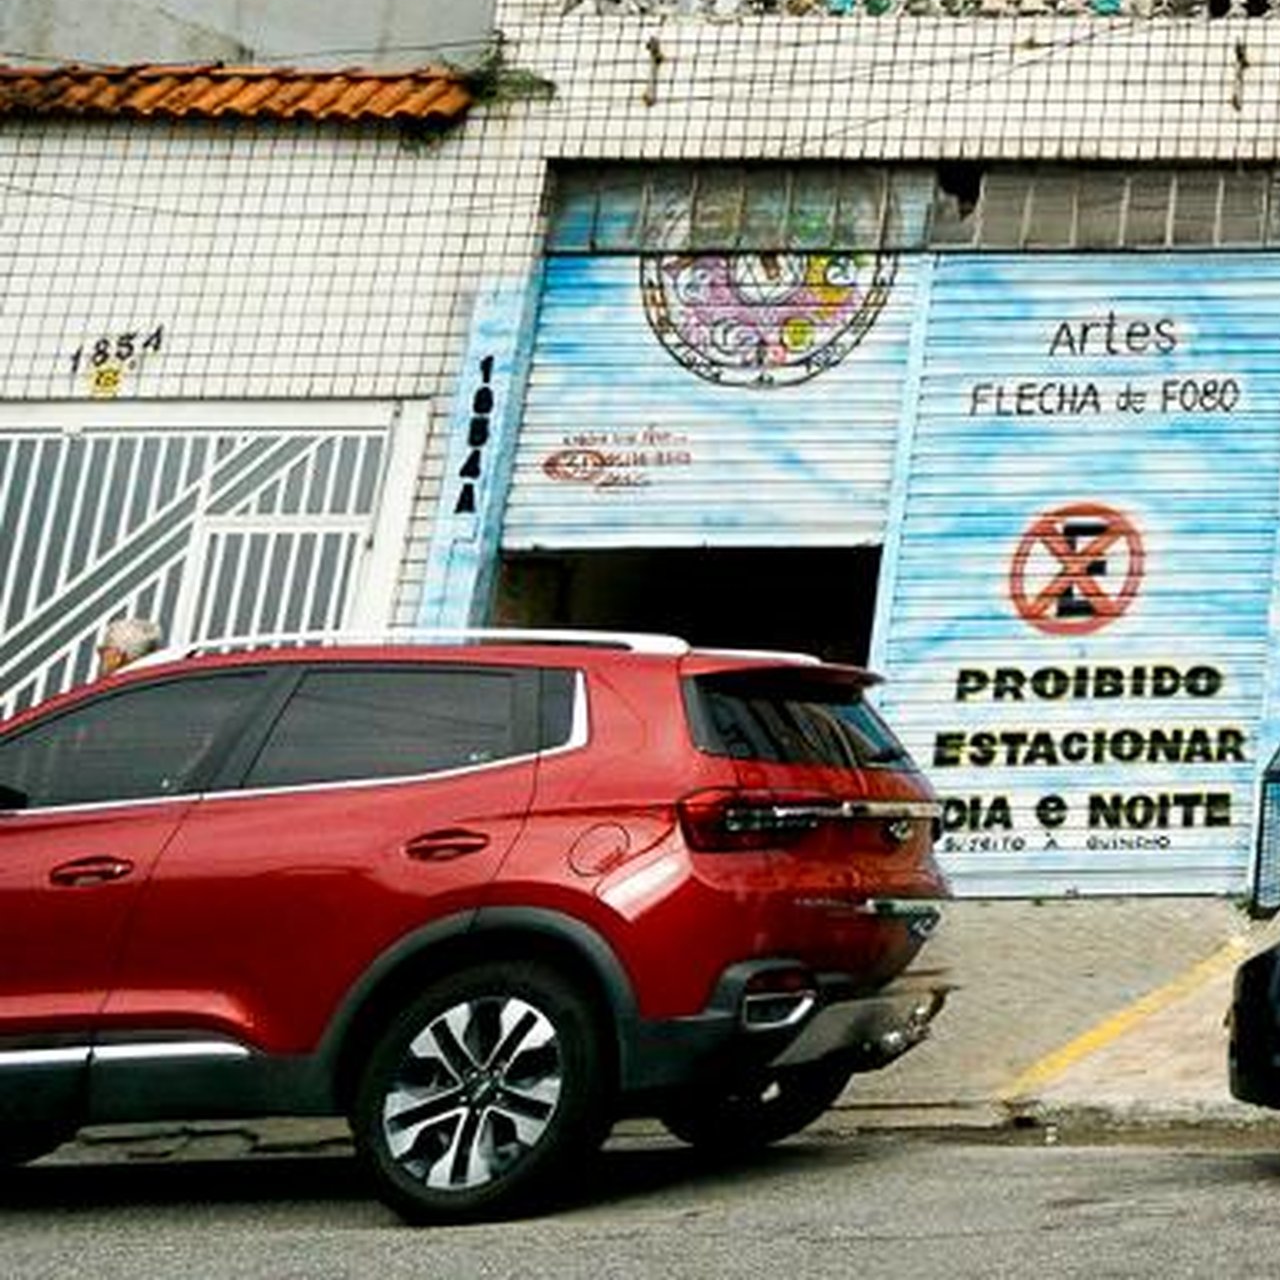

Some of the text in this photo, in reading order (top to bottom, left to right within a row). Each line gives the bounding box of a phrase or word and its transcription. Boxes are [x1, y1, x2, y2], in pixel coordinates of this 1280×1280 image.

[1049, 311, 1177, 356] Artes
[968, 381, 1101, 416] FLECHA
[1116, 381, 1147, 414] de
[955, 666, 1223, 702] PROIBIDO
[933, 729, 1246, 767] ESTACIONAR
[941, 796, 1013, 831] DIA
[1088, 793, 1231, 829] NOITE
